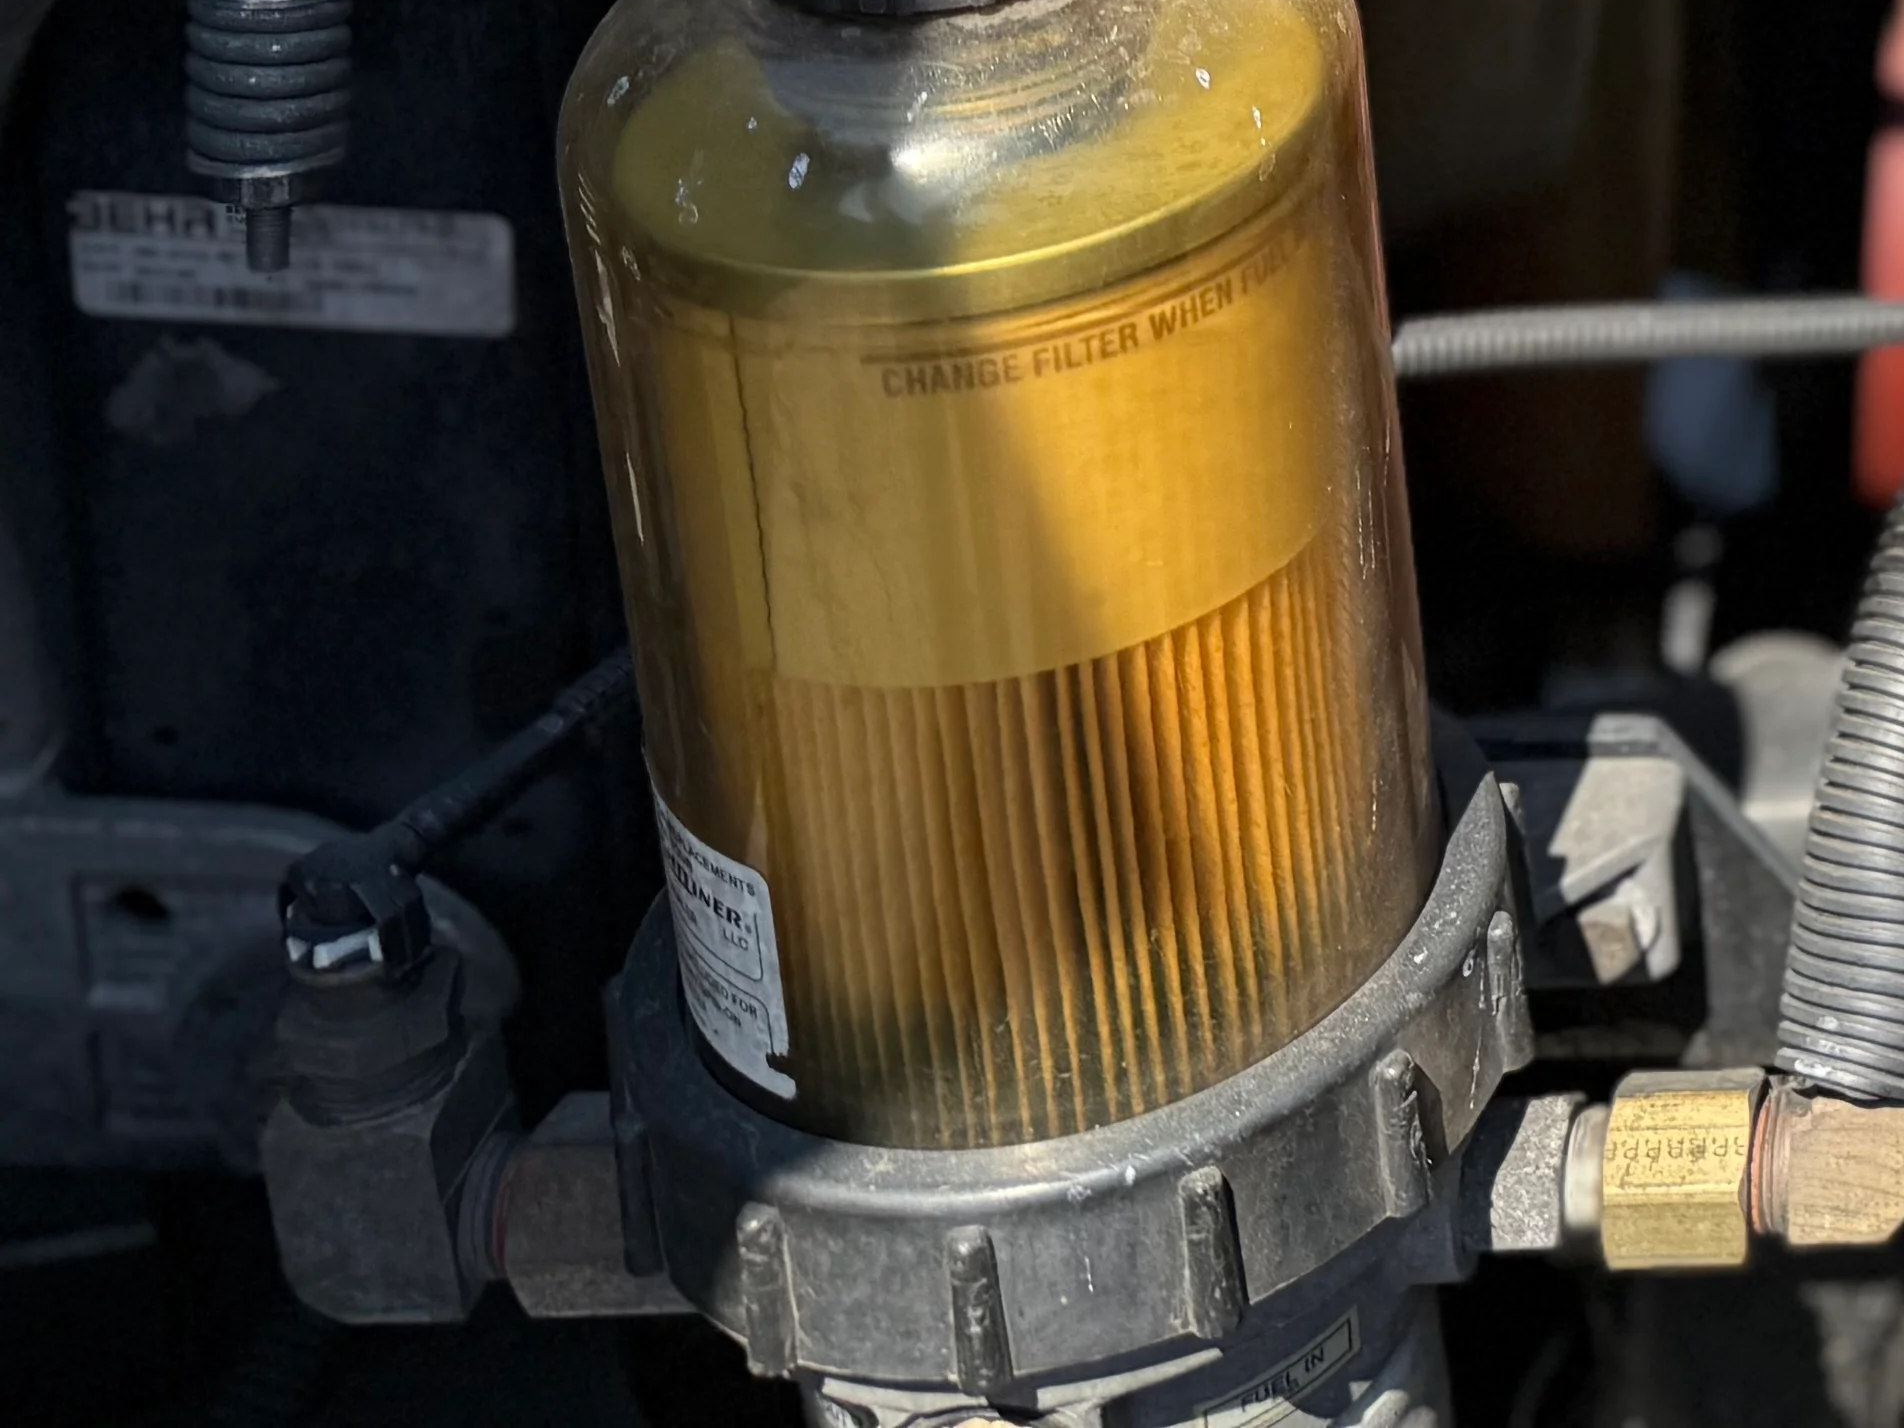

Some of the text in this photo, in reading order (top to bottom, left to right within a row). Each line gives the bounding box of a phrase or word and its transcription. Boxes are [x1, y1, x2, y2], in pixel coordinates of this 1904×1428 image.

[881, 353, 1023, 399] CHANGE
[1031, 321, 1141, 380] FILTER
[1148, 276, 1233, 341] WHEN
[1240, 1346, 1325, 1414] FUEL IN
